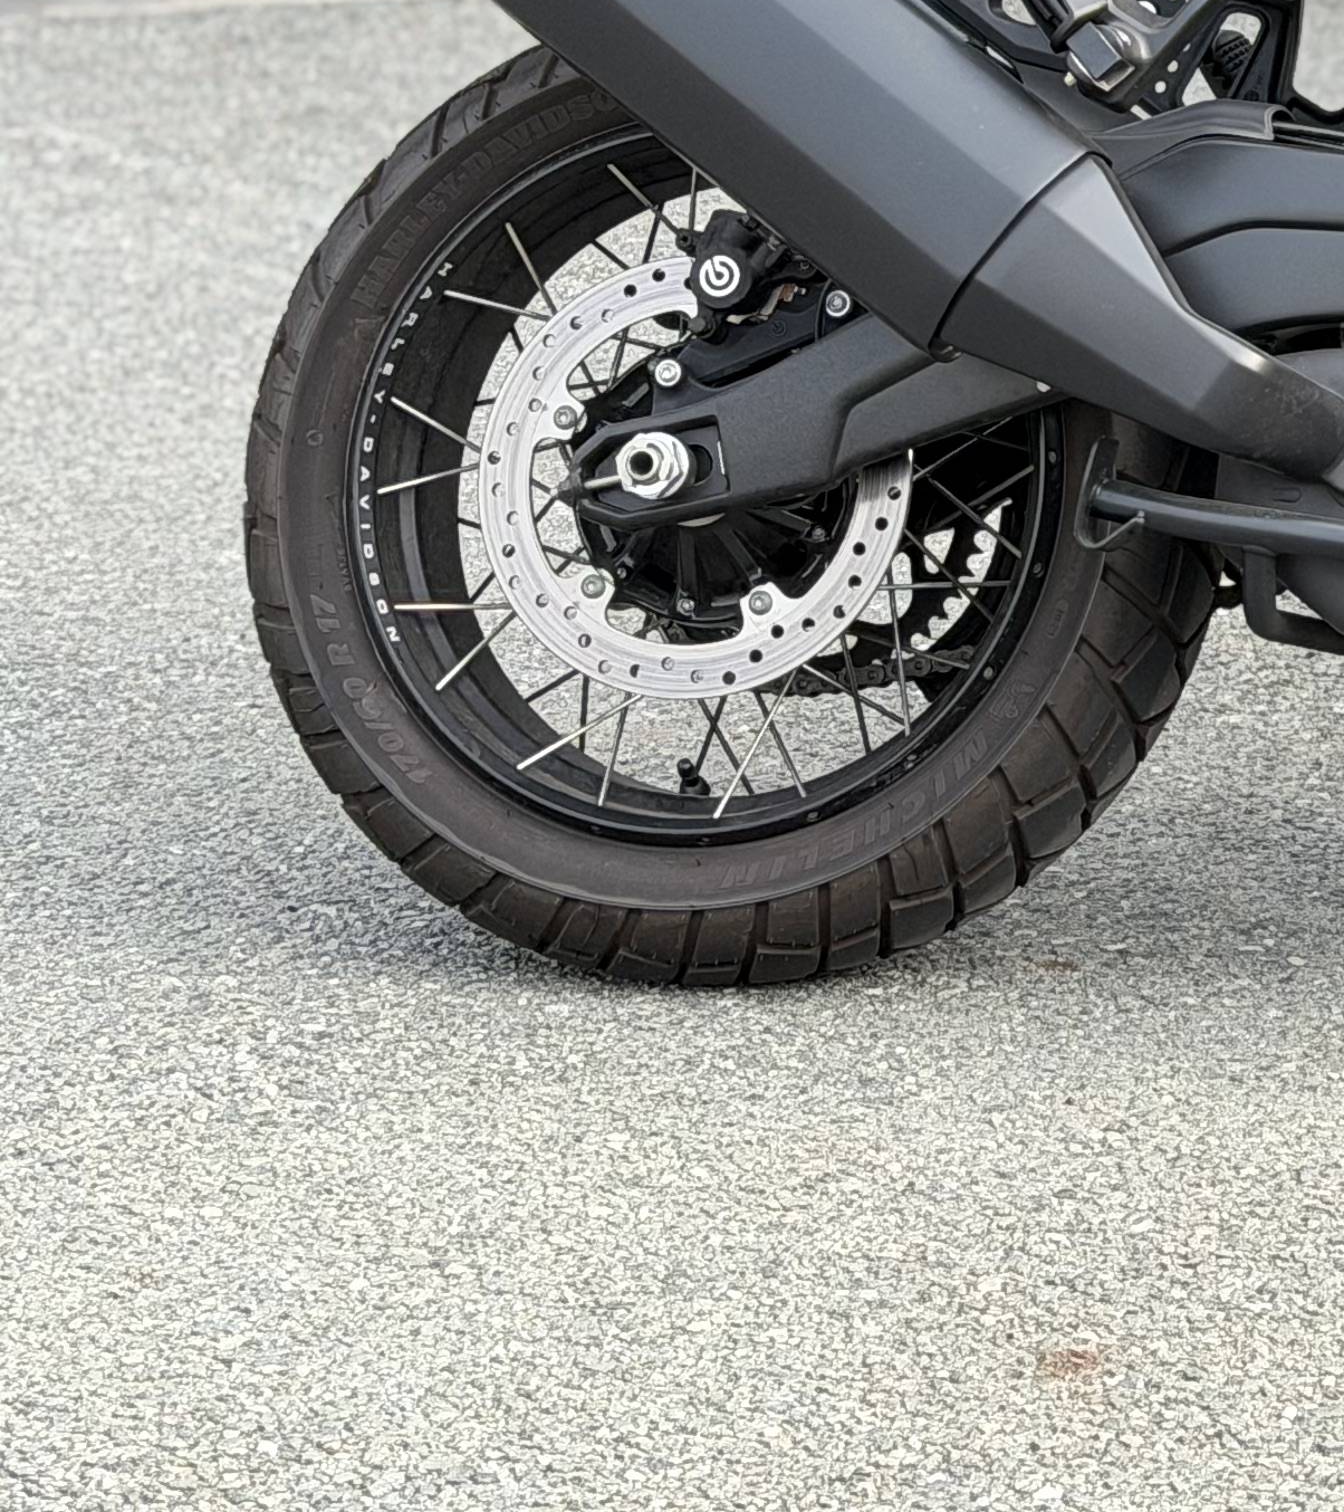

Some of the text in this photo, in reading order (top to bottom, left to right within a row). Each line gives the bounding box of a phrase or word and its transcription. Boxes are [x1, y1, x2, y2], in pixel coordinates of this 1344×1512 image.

[350, 87, 620, 310] HARLEY-DAVIDSO
[359, 261, 453, 643] HARLEY-DAVIDSON
[310, 594, 341, 632] 17
[717, 734, 989, 889] MICHELIN
